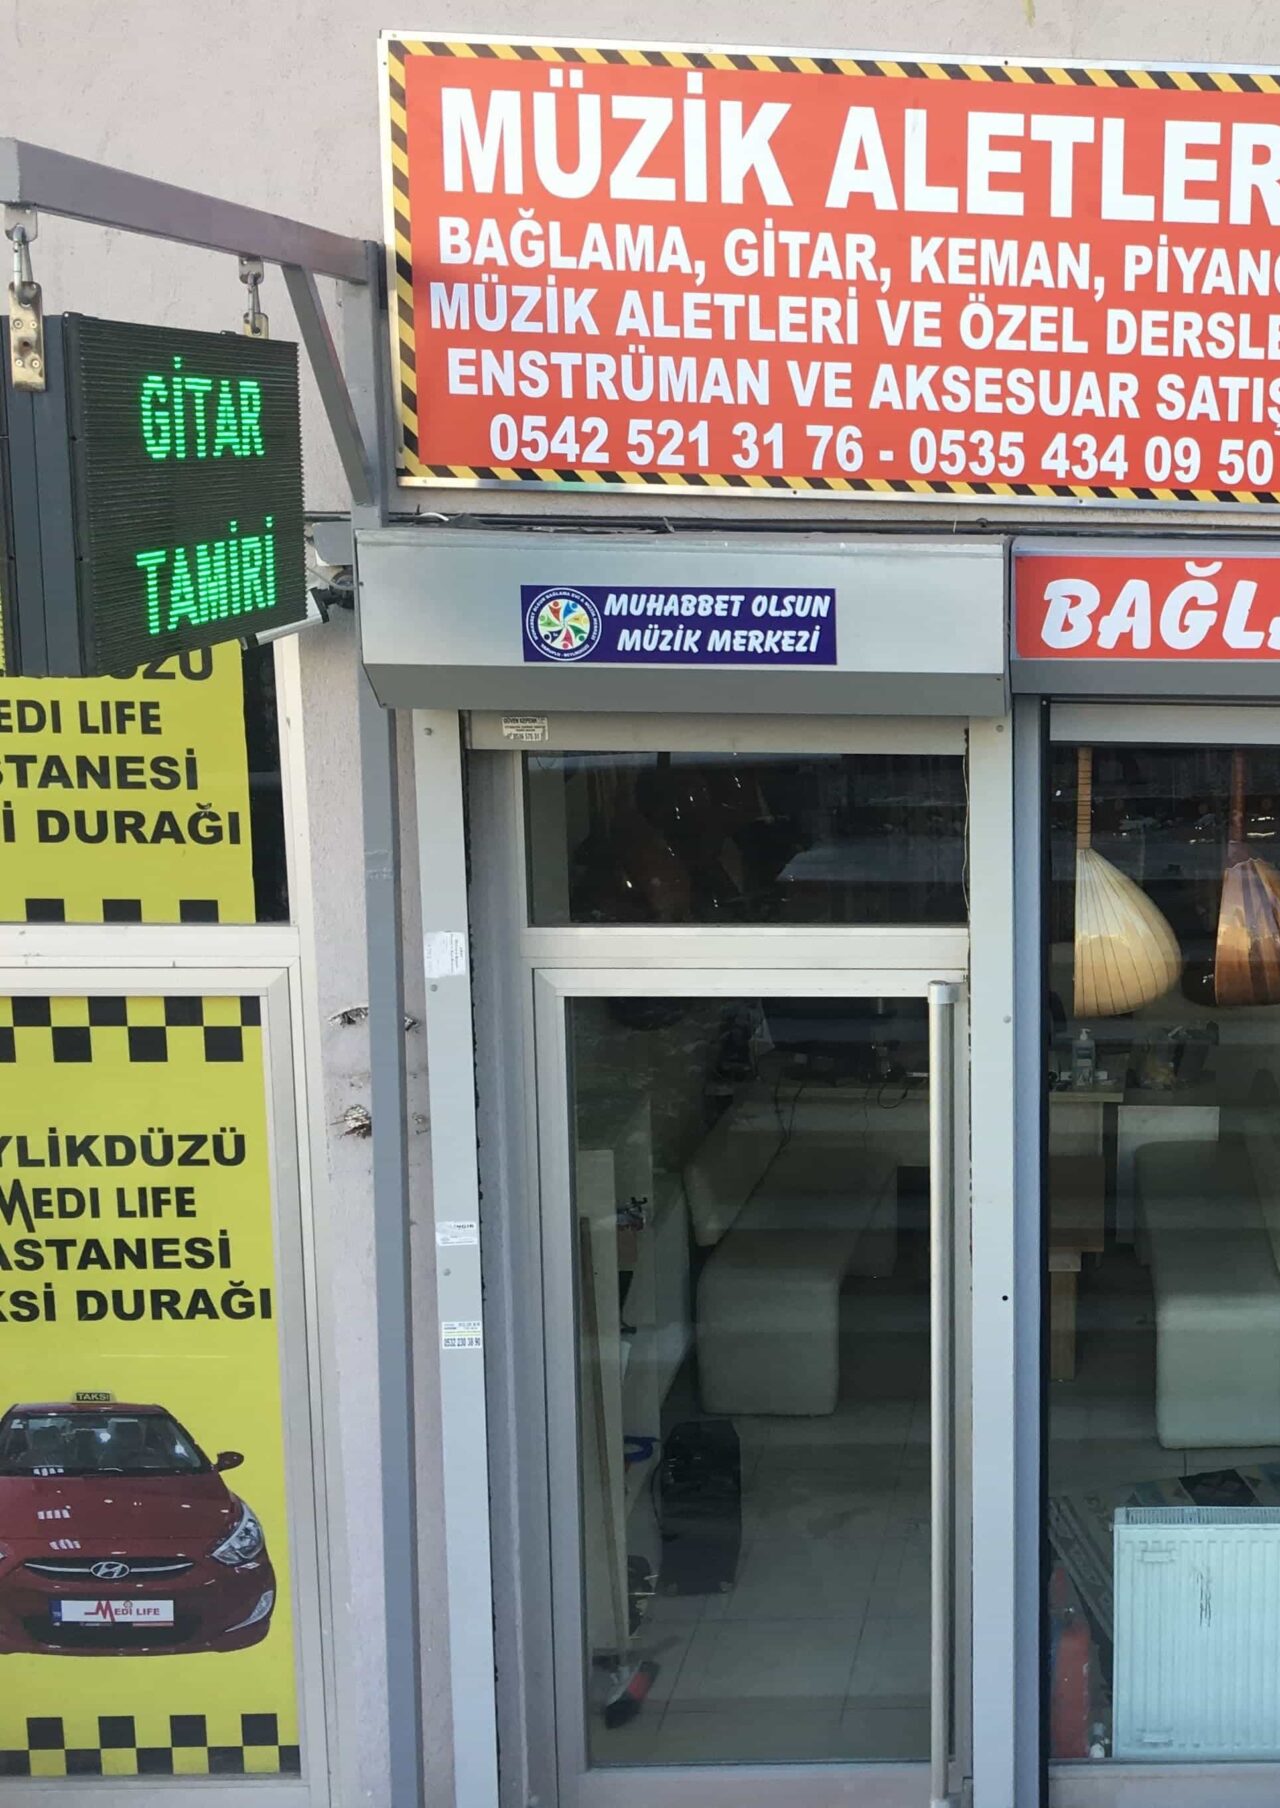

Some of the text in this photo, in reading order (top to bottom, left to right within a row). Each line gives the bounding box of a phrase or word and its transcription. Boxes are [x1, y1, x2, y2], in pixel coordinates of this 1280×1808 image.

[441, 68, 793, 206] MÜZİK
[439, 208, 705, 286] BAĞLAMA,
[724, 218, 891, 293] GİTAR,
[911, 236, 1104, 302] KEMAN,
[430, 273, 600, 335] MÜZİK
[615, 275, 858, 346] ALETLERİ
[876, 299, 942, 348] VE
[960, 293, 1088, 353] ÖZEL
[448, 344, 769, 405] ENSTRÜMAN
[787, 360, 852, 408] VE
[869, 364, 1140, 418] AKSESUAR
[141, 357, 264, 458] GİTAR
[490, 414, 609, 463] 0542
[627, 419, 708, 466] 521
[732, 422, 783, 469] 31
[806, 425, 863, 472] 76
[910, 428, 1025, 477] 0535
[1041, 433, 1128, 480] 434
[1145, 436, 1200, 483] 09
[1218, 439, 1273, 485] 50
[136, 517, 275, 634] TAMİRİ
[604, 593, 830, 618] MUHABBET OLSUN
[617, 624, 702, 653] MÜZİK
[707, 625, 820, 654] MERKEZİ
[79, 701, 162, 734] LIFE
[0, 749, 198, 790] TANESİ
[37, 803, 240, 844] DURAĞI
[117, 1187, 196, 1218] LIFE
[0, 1281, 272, 1322] Sİ DURAĞI
[136, 1608, 160, 1616] LIFE
